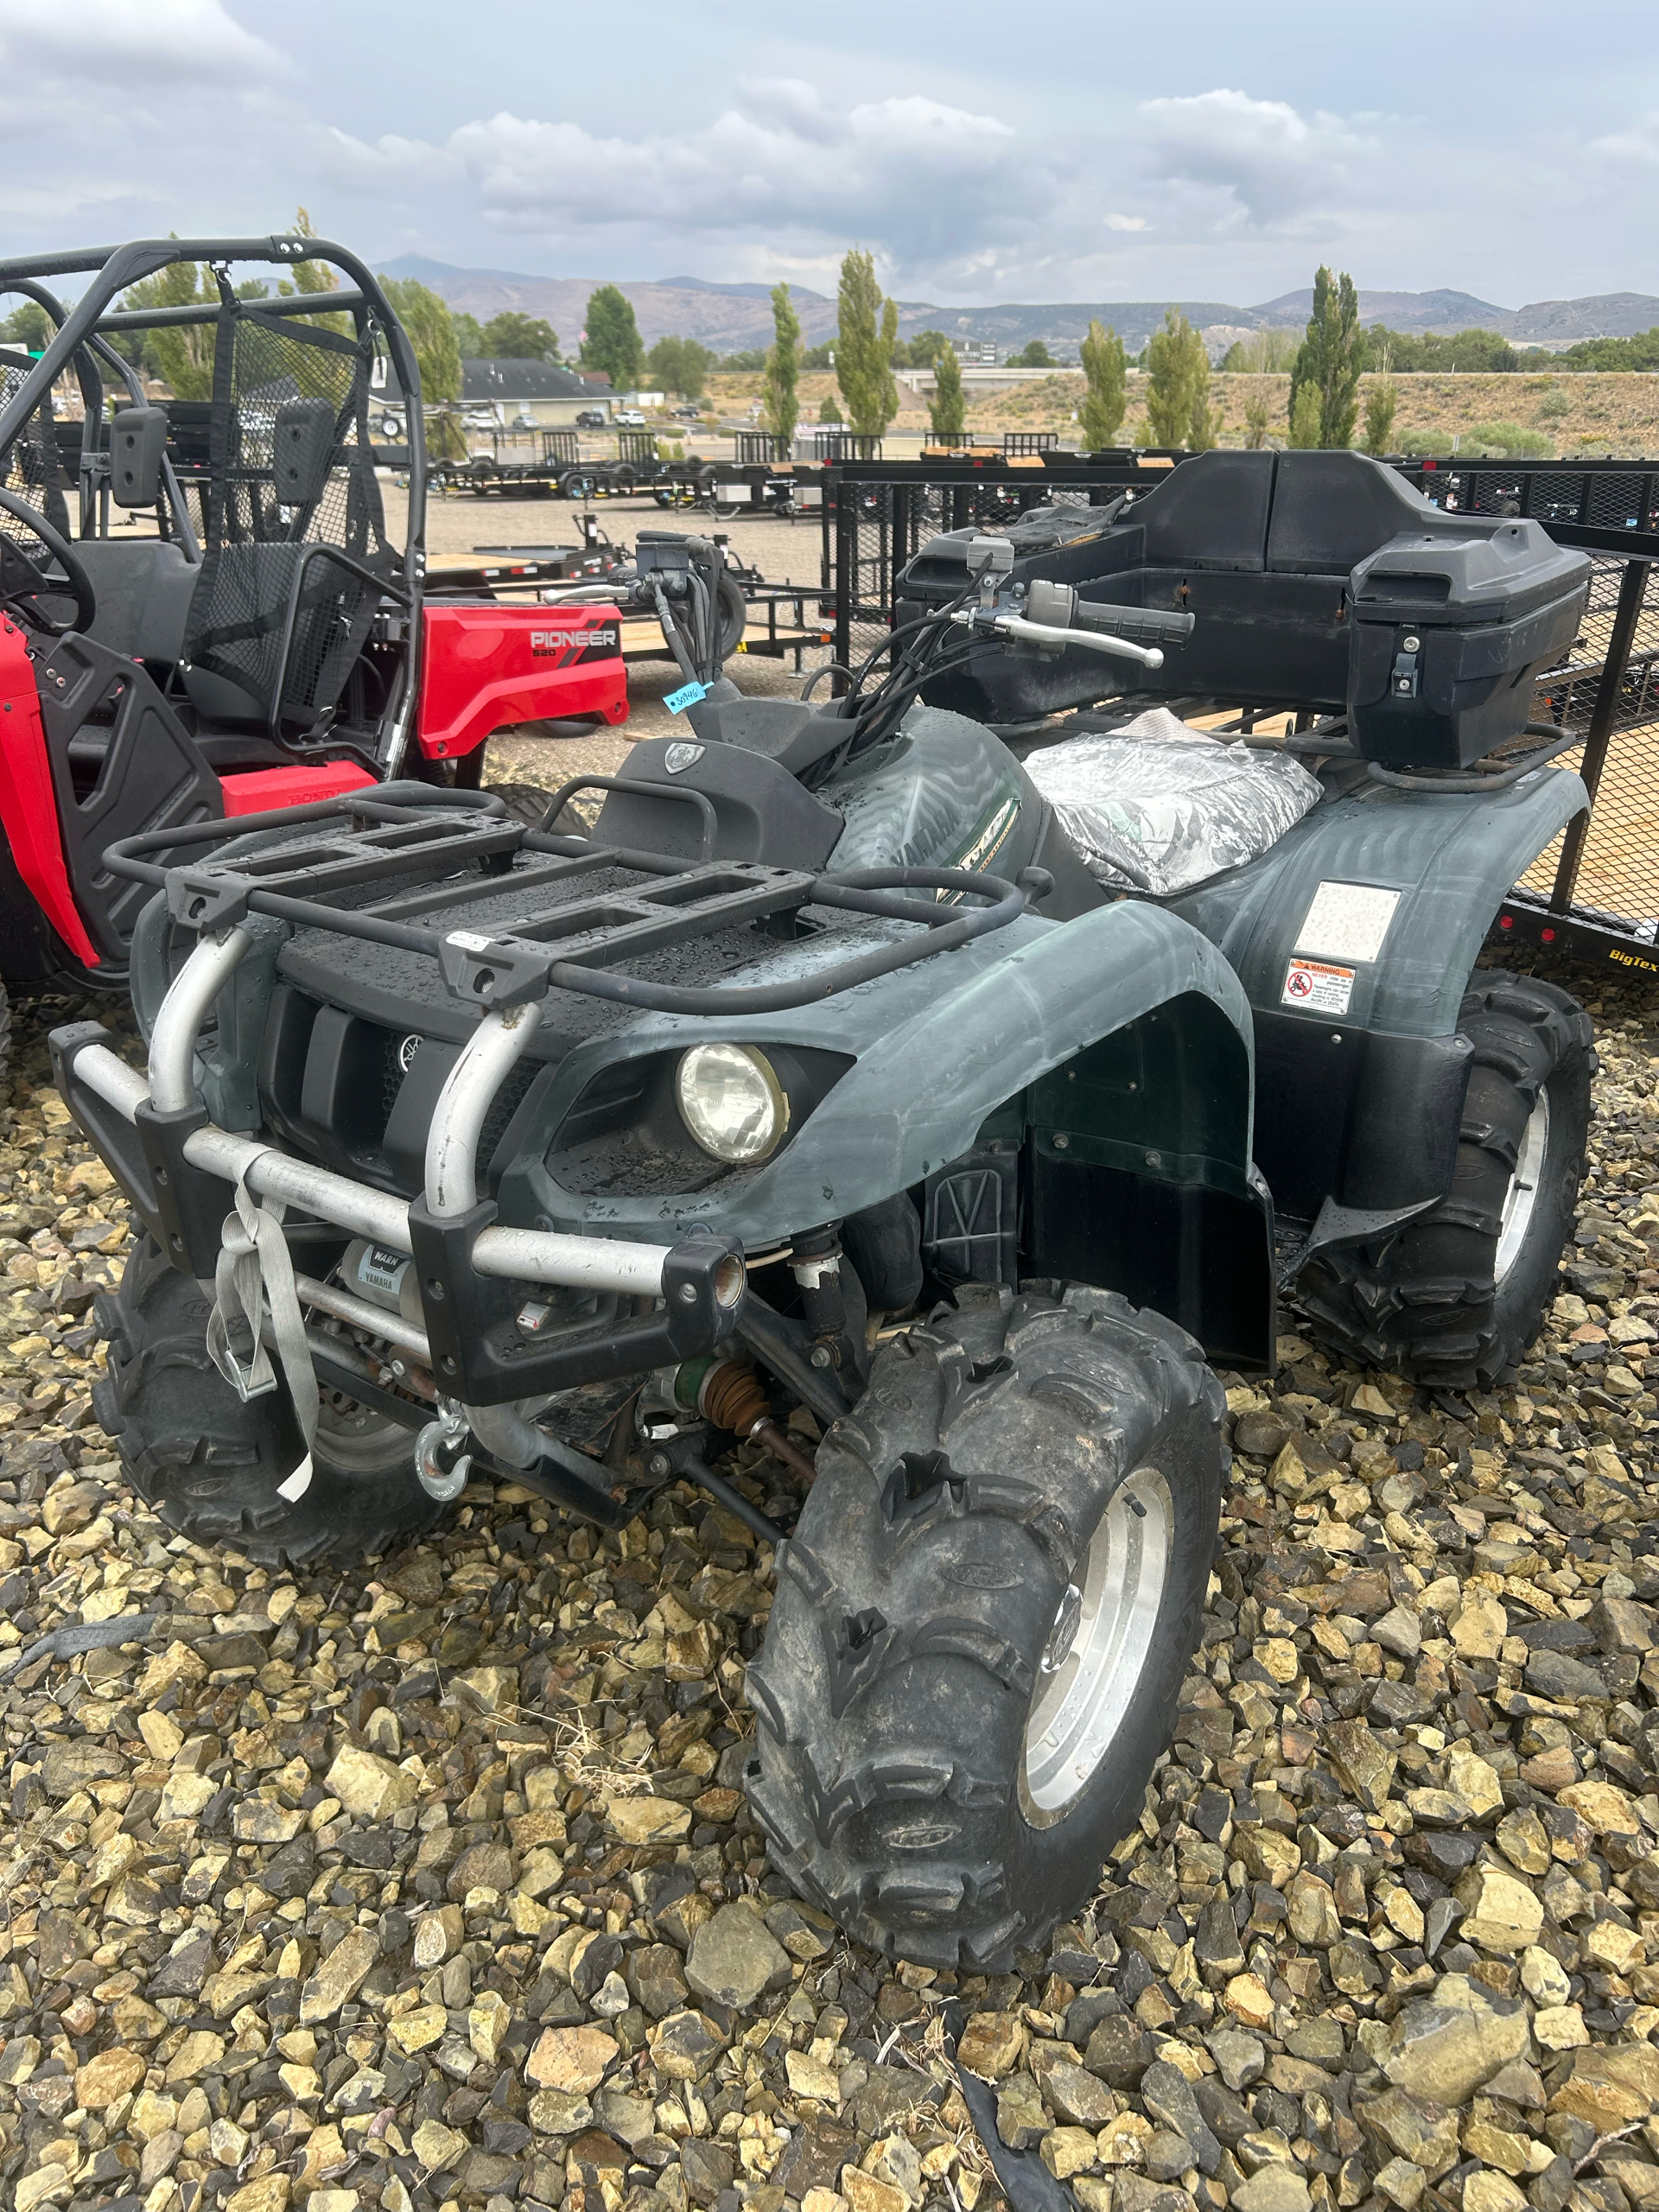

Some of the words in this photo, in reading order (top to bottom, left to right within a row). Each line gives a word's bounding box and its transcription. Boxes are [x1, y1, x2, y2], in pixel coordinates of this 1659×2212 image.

[531, 630, 616, 647] PIONEER
[1609, 949, 1659, 972] BigTex
[1311, 965, 1340, 976] WARNING
[374, 1251, 399, 1267] WARN
[365, 1272, 392, 1291] YAMAHA
